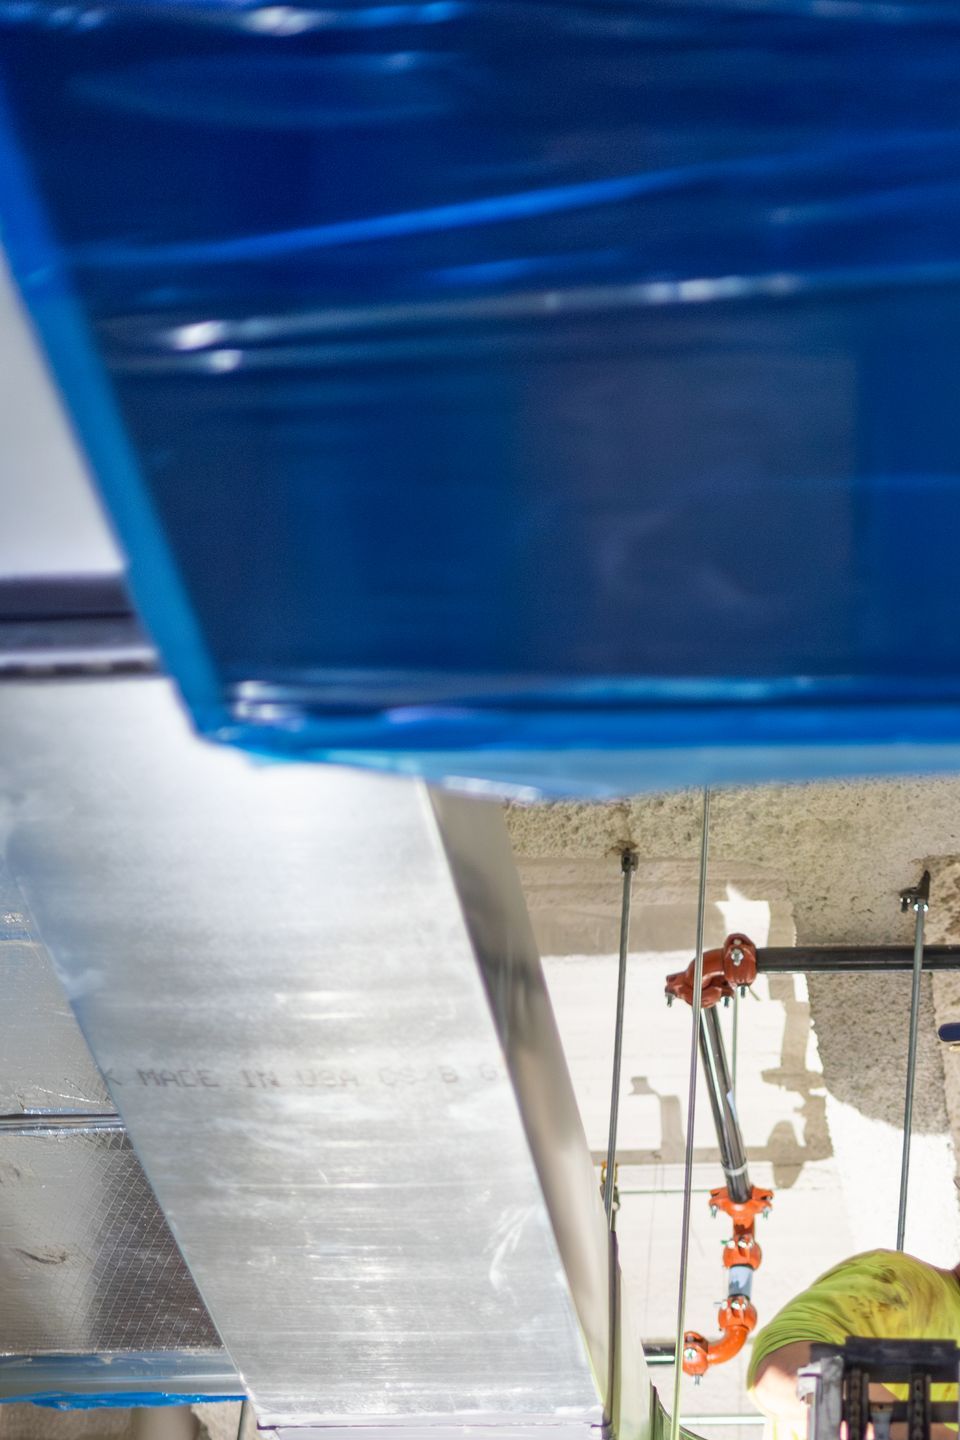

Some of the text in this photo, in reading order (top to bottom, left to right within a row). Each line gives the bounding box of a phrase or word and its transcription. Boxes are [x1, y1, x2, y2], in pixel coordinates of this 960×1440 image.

[136, 1067, 219, 1088] MADE
[241, 1069, 281, 1088] IN
[296, 1068, 359, 1088] USA
